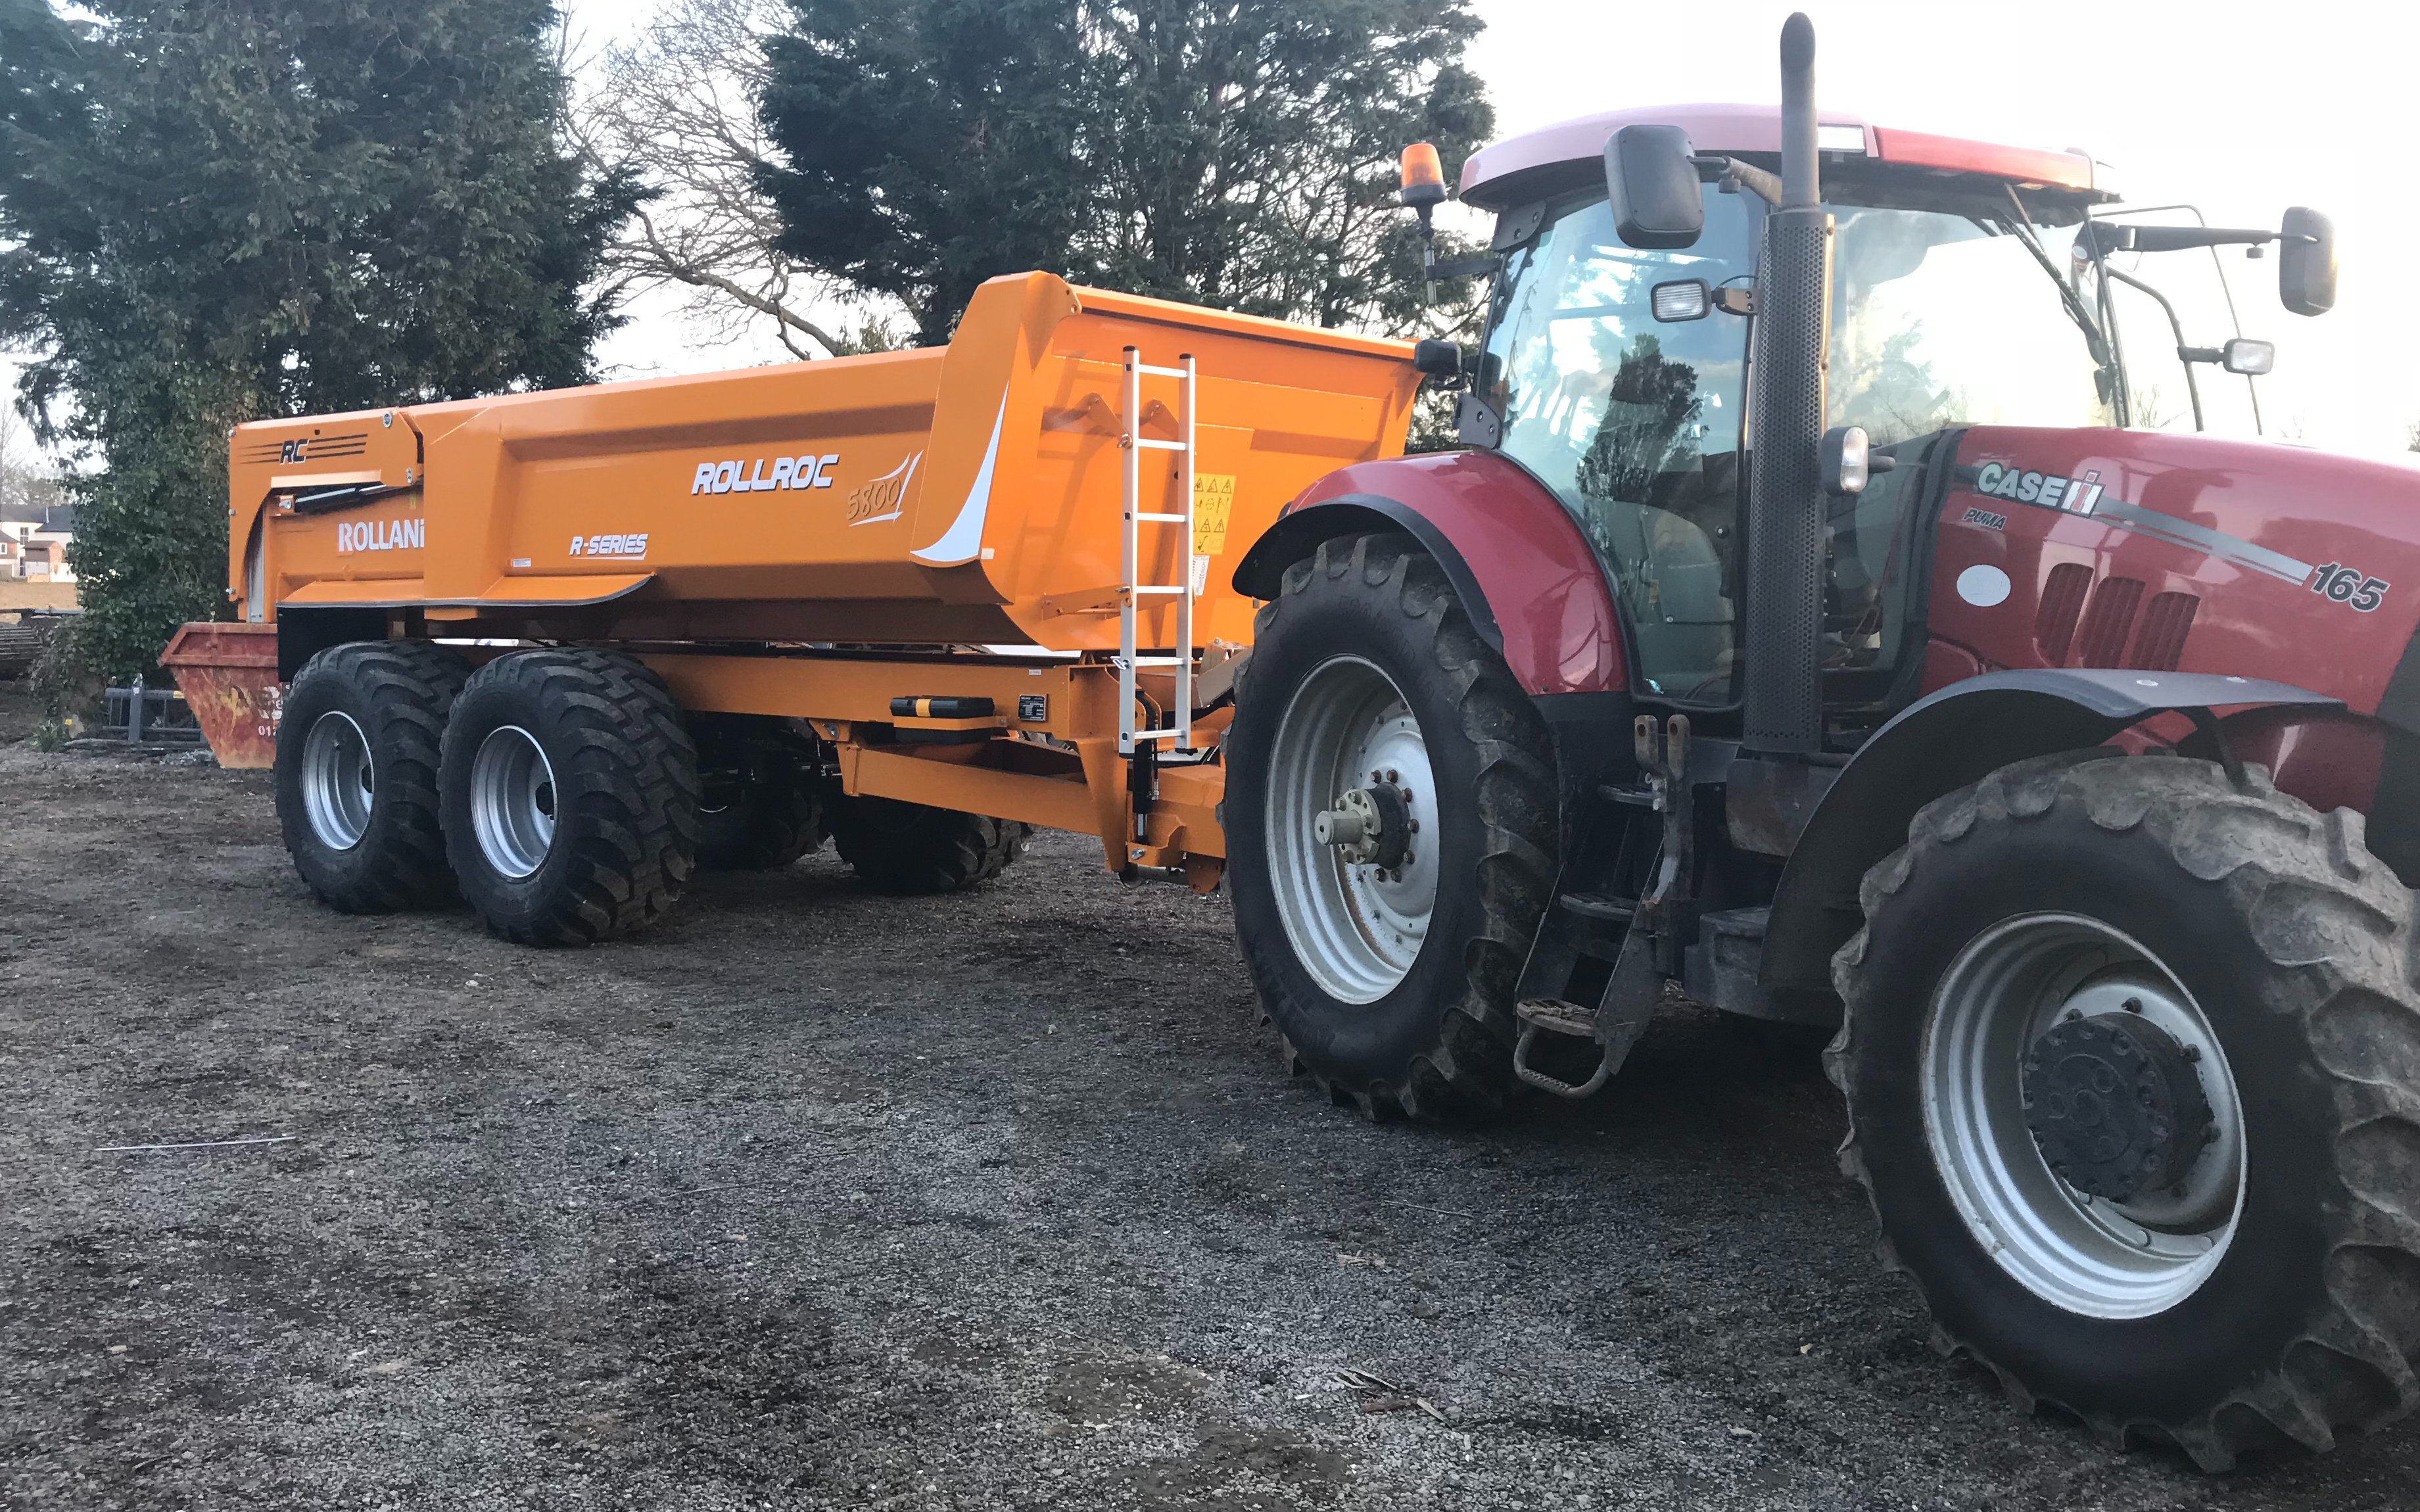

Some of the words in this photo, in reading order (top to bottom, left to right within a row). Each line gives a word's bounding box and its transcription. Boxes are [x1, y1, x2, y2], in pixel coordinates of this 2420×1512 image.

[279, 438, 309, 465] RC
[692, 454, 840, 496] ROLLROC
[1978, 463, 2068, 507] CASE
[845, 476, 901, 521] 5800
[338, 518, 425, 552] ROLLAN
[1962, 508, 2008, 531] PUMA
[569, 534, 648, 555] R-SERIES
[2310, 560, 2391, 613] 165
